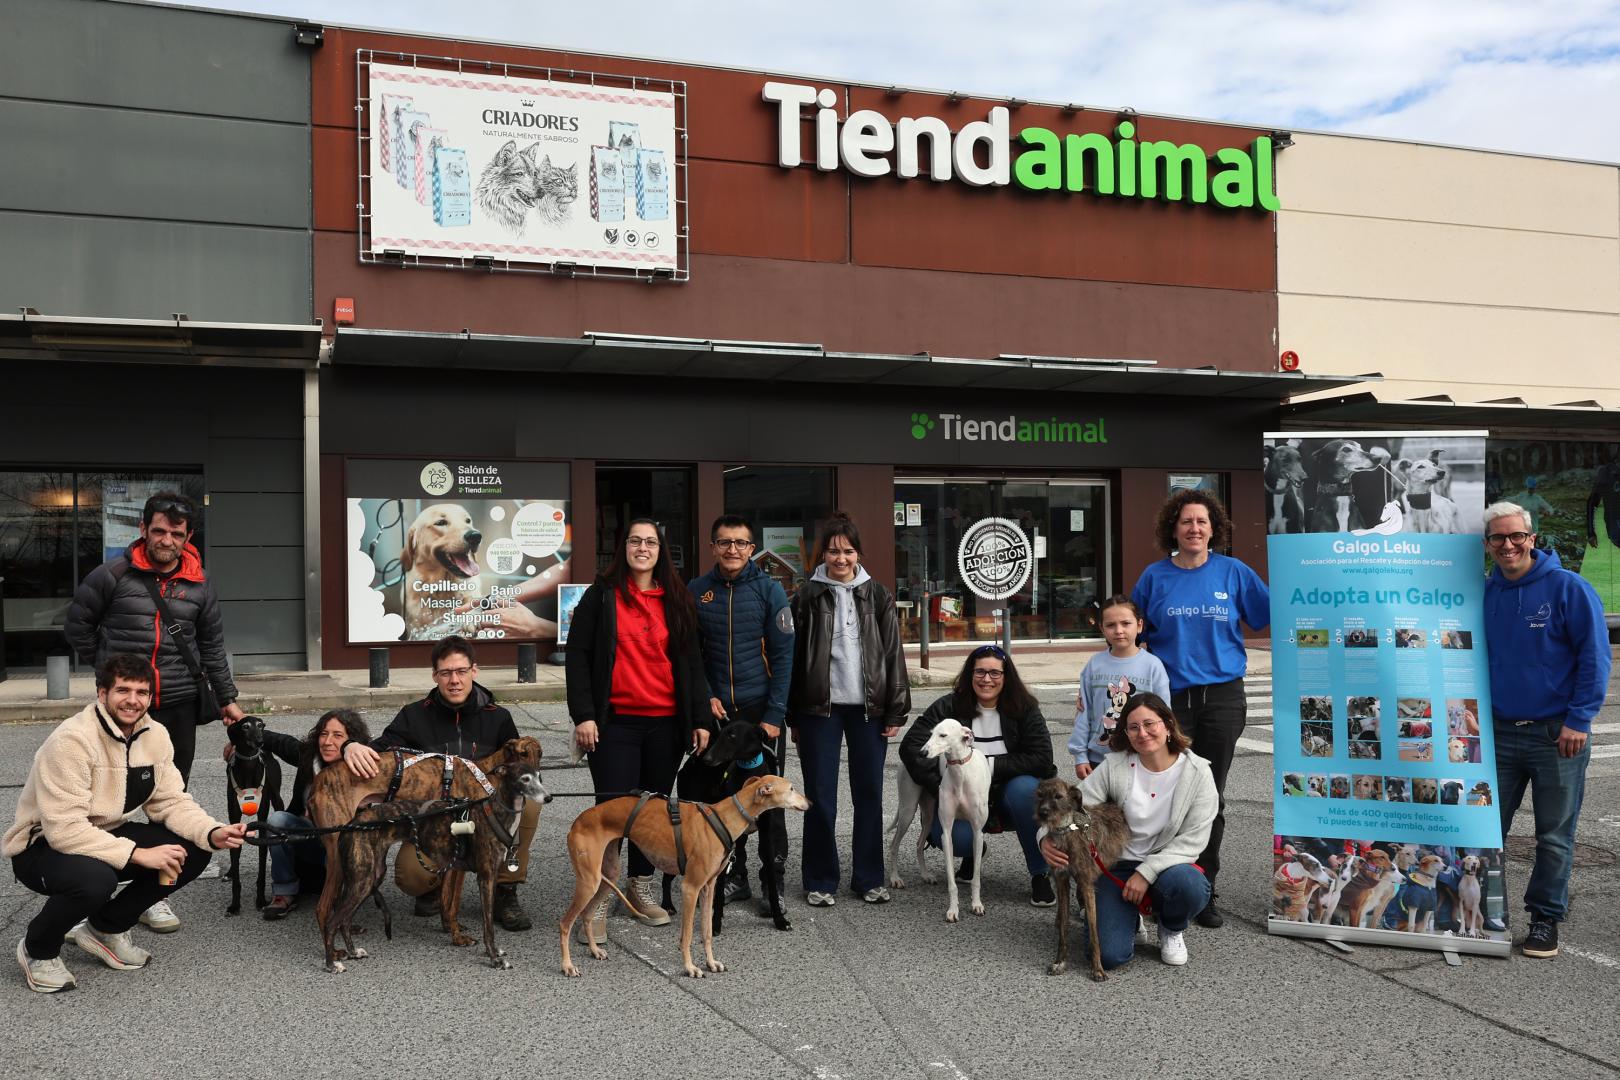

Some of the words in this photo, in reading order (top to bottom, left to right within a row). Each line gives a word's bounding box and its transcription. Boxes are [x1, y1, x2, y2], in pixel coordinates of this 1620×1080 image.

[482, 109, 579, 132] CRIADORES
[482, 130, 541, 140] NATURALMENTE
[543, 135, 579, 143] SABROSO
[762, 81, 1281, 212] Tiendanimal
[939, 413, 1108, 443] Tiendanimal
[458, 465, 484, 475] Salón
[486, 466, 498, 475] de
[458, 476, 502, 485] BELLEZA
[981, 541, 1006, 553] 100%
[1332, 540, 1380, 556] Galgo
[1384, 540, 1421, 554] Leku
[965, 546, 1026, 570] ADOPCIÓN
[1301, 558, 1337, 566] Asociación
[1392, 557, 1421, 566] Adopción
[1430, 559, 1453, 567] Galgos
[985, 565, 1011, 577] 100%
[1342, 567, 1414, 576] www.galgoleku.org
[1009, 568, 1024, 590] AMIGO
[412, 580, 476, 594] Cepillado
[491, 585, 522, 597] Baño
[470, 598, 517, 609] CORTE
[1290, 586, 1370, 608] Adopta
[1375, 590, 1401, 604] un
[1406, 587, 1465, 610] Galgo
[420, 598, 463, 612] Masaje
[1167, 605, 1199, 617] Galgo
[1202, 605, 1228, 615] Leku
[443, 612, 501, 626] Stripping
[1289, 628, 1293, 636] 1
[1335, 628, 1342, 636] 2
[1386, 628, 1392, 636] 3
[1328, 807, 1346, 816] Más
[1349, 808, 1359, 816] de
[1361, 809, 1381, 817] 400
[1383, 811, 1412, 821] galgos
[1414, 812, 1447, 822] felices.
[1317, 816, 1329, 825] Tú
[1330, 818, 1362, 827] puedes
[1380, 820, 1388, 828] el
[1391, 821, 1425, 832] cambio,
[1427, 824, 1460, 834] adopta
